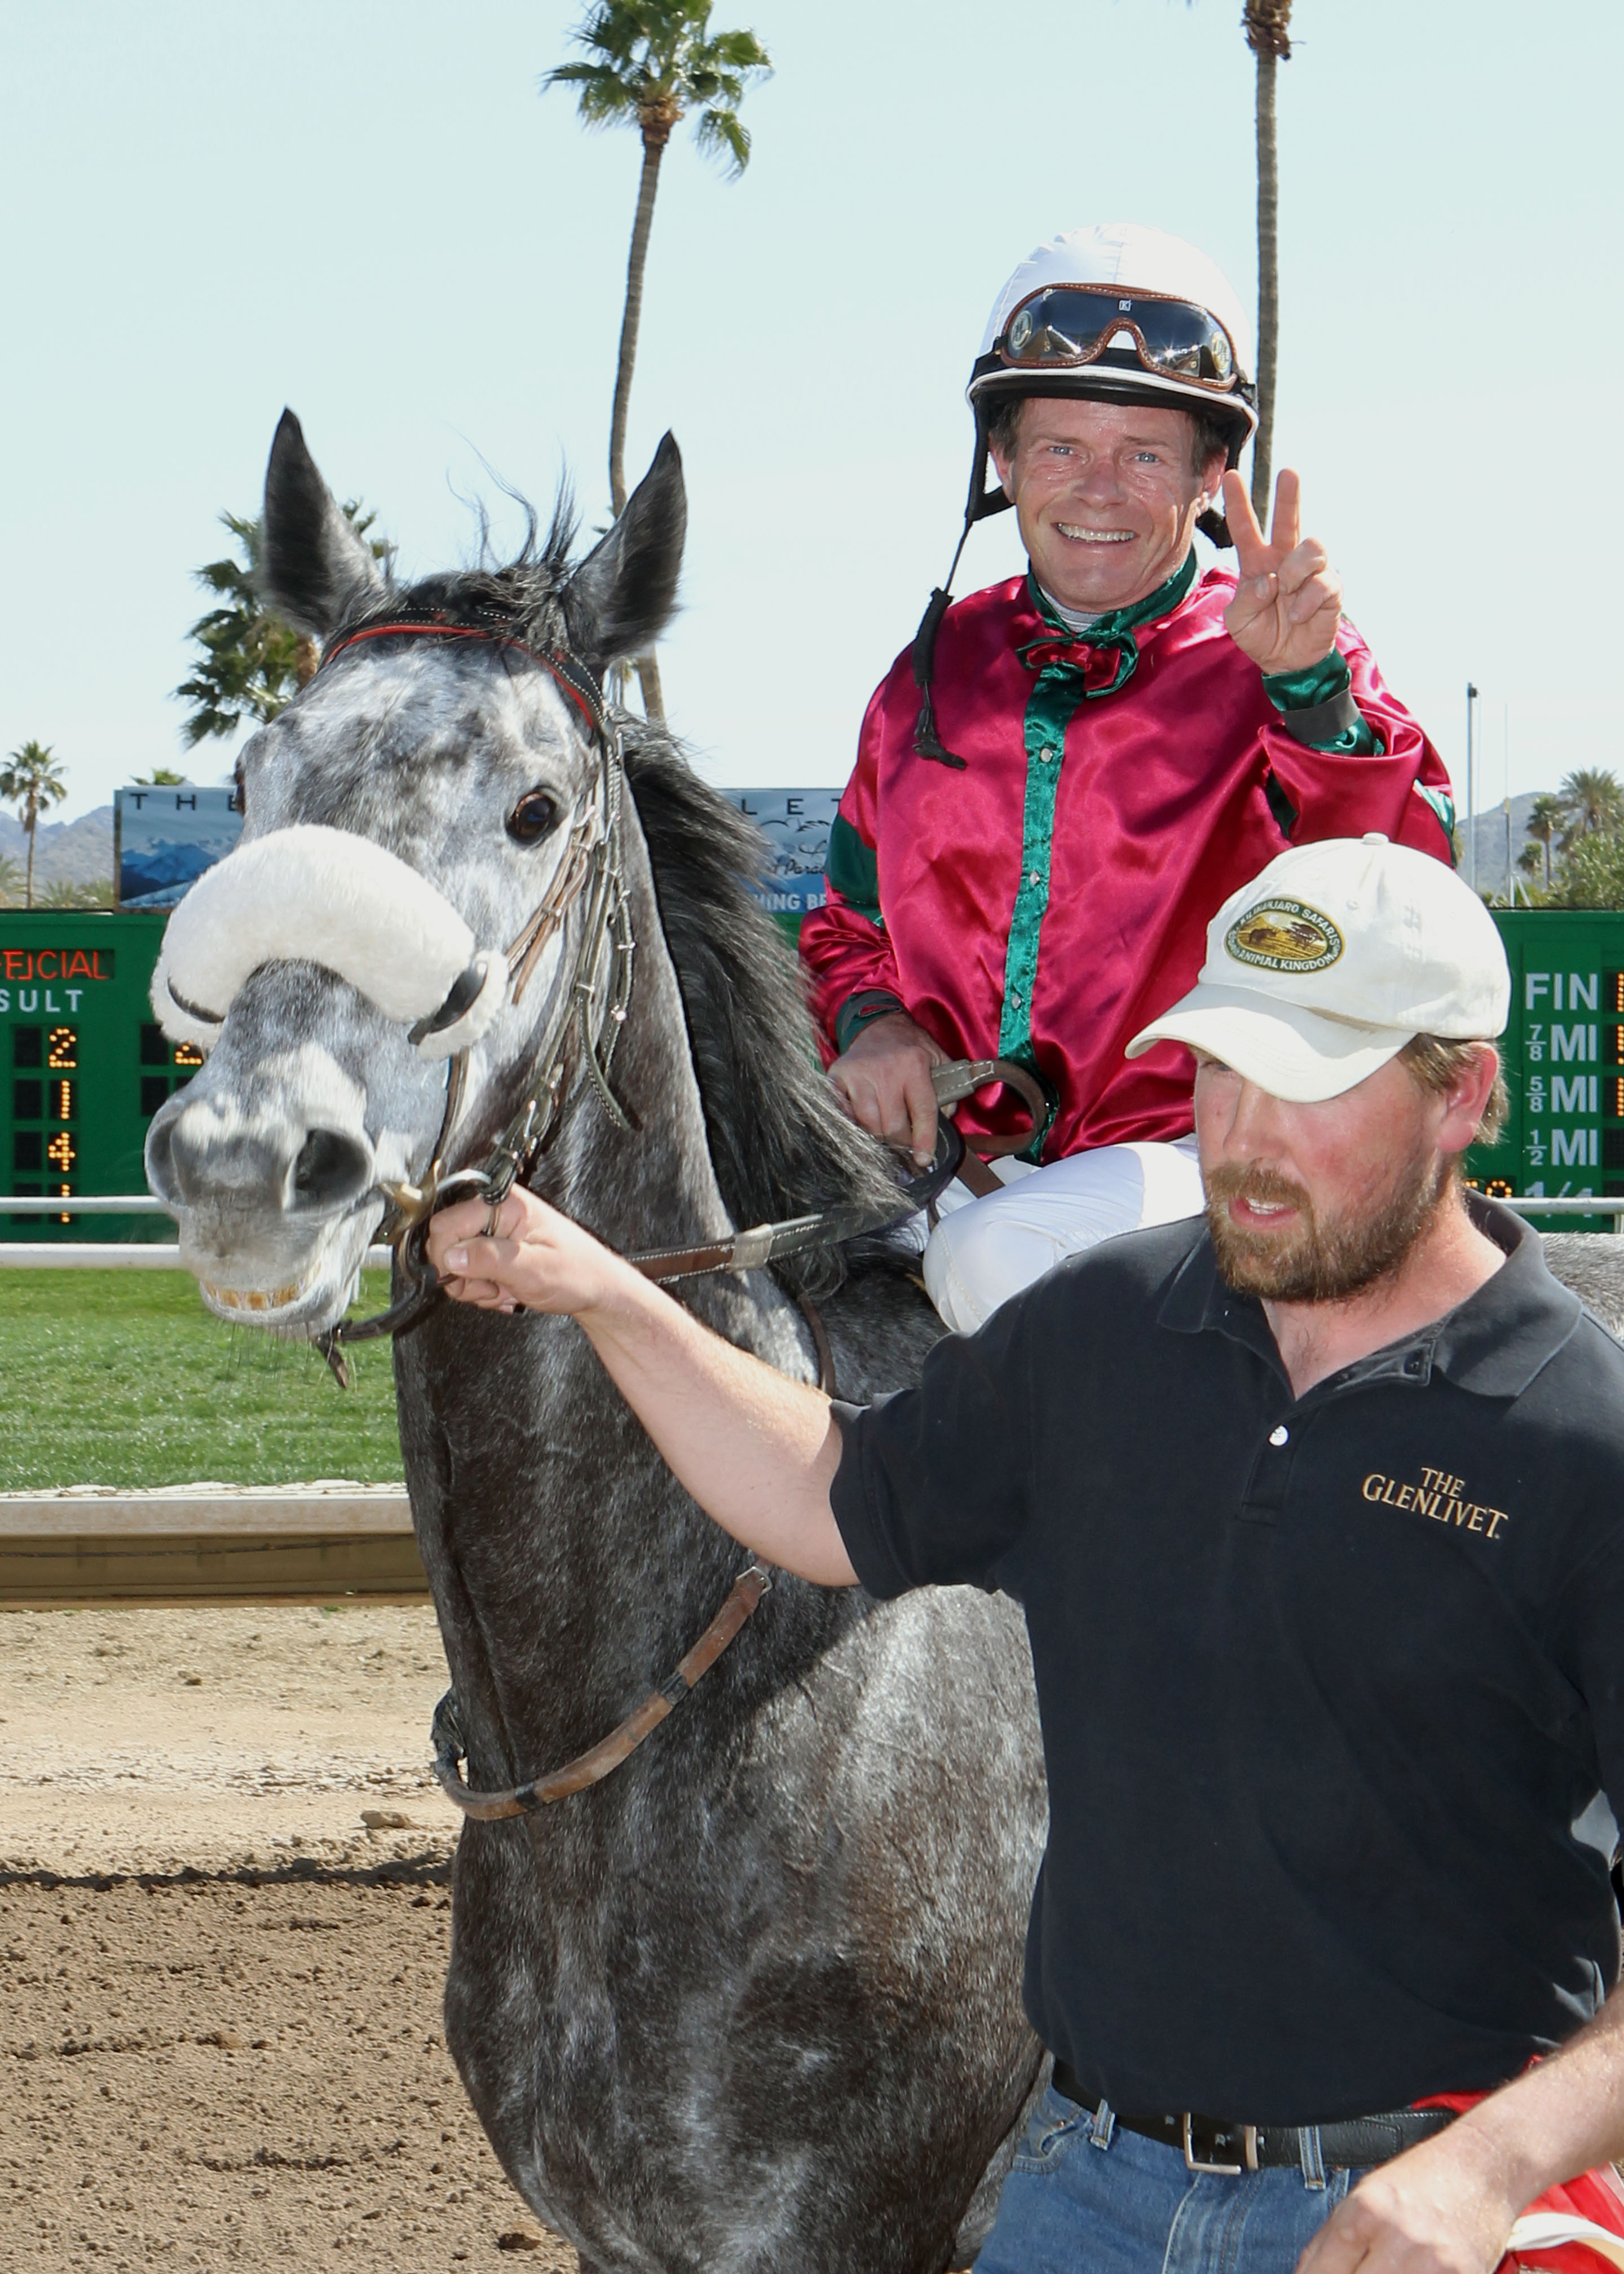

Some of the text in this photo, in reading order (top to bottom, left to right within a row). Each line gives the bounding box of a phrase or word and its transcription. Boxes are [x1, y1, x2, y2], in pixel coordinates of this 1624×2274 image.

[1301, 909, 1340, 946] SAFARIS
[1238, 949, 1335, 970] ANIMAL KINGDOM
[1525, 973, 1598, 1010] FIN
[49, 1028, 76, 1068] 2
[1551, 1024, 1597, 1061] MI
[61, 1079, 70, 1120] 1
[1551, 1076, 1597, 1113] MI
[48, 1131, 76, 1172] 4
[1552, 1129, 1598, 1166] MI
[1421, 1467, 1466, 1498] THE
